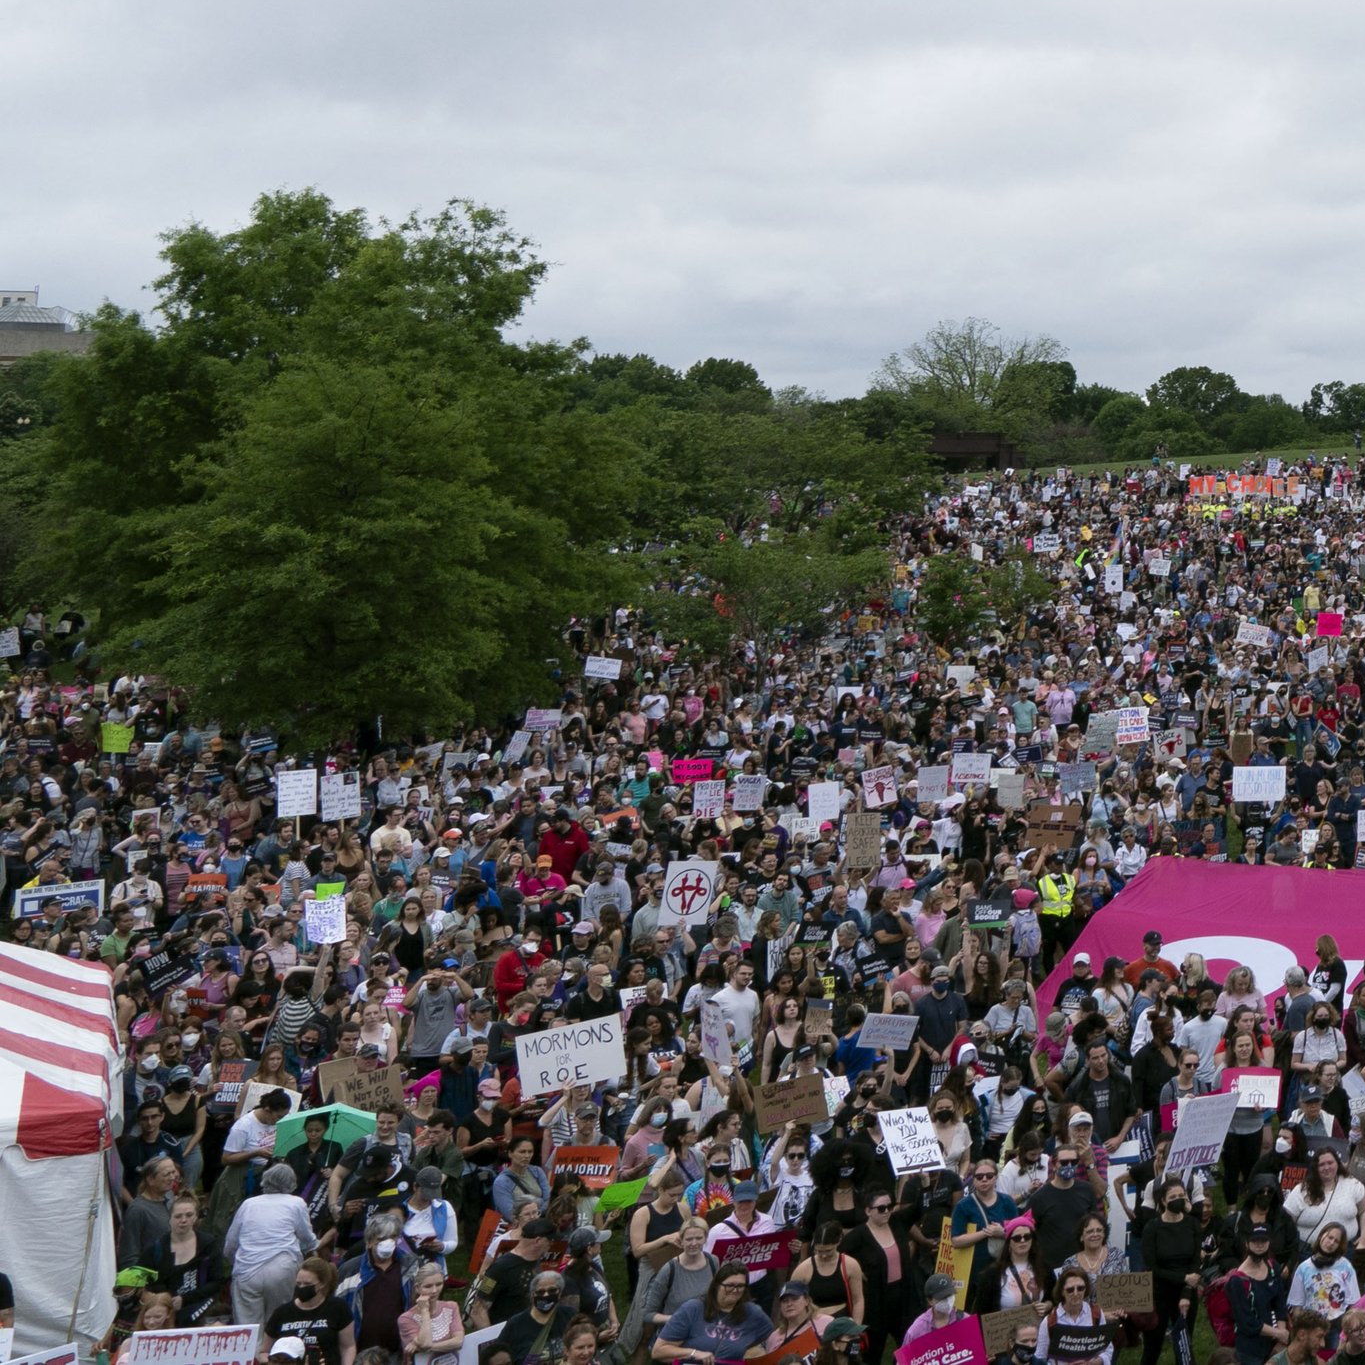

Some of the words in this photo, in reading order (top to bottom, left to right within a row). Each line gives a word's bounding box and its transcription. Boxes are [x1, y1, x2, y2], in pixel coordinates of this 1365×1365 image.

[1189, 476, 1216, 496] MY
[1226, 474, 1299, 498] CHOICE
[695, 808, 715, 818] DIE
[854, 813, 876, 827] KEEP
[852, 837, 875, 850] SAFE
[524, 1022, 614, 1059] MORMONS
[555, 1052, 573, 1067] FOR
[220, 1062, 246, 1074] FIGHT
[220, 1072, 242, 1083] BACK
[345, 1077, 365, 1092] WE
[367, 1068, 389, 1087] Will
[540, 1063, 589, 1089] ROE
[353, 1090, 373, 1103] NOT
[376, 1086, 390, 1096] GO
[880, 1113, 905, 1127] WHO
[906, 1110, 929, 1124] MADE
[897, 1124, 918, 1137] YOU
[554, 1162, 614, 1176] MAJORITY
[1284, 1166, 1308, 1177] FIGHT
[725, 1246, 750, 1259] OFF
[748, 1241, 780, 1256] OUR
[726, 1238, 761, 1253] BANS
[1101, 1273, 1151, 1288] SCOTUS
[945, 1341, 955, 1352] is
[1058, 1334, 1097, 1345] Abortion
[1058, 1341, 1088, 1351] Health
[941, 1347, 974, 1364] Care.
